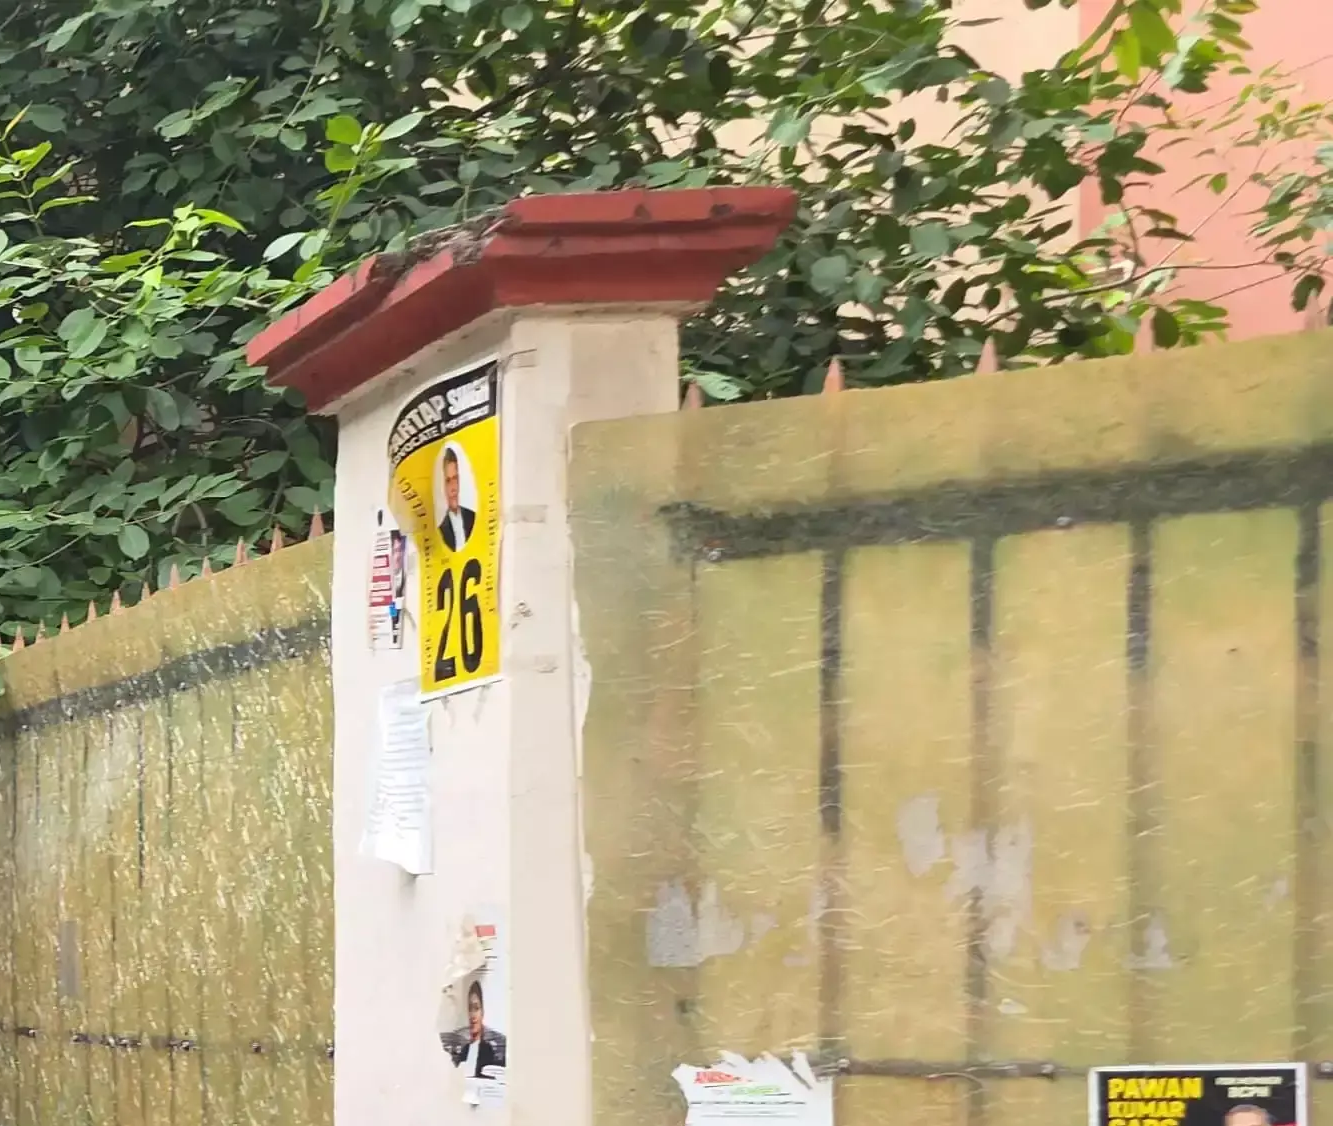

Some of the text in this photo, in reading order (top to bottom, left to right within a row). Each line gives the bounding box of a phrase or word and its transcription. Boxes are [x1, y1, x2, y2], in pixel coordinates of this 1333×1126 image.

[390, 394, 446, 456] ARTAP
[392, 425, 440, 464] DVOCATE
[434, 557, 483, 683] 26
[1107, 1076, 1204, 1100] PAWAN
[1108, 1100, 1186, 1118] KUMAR
